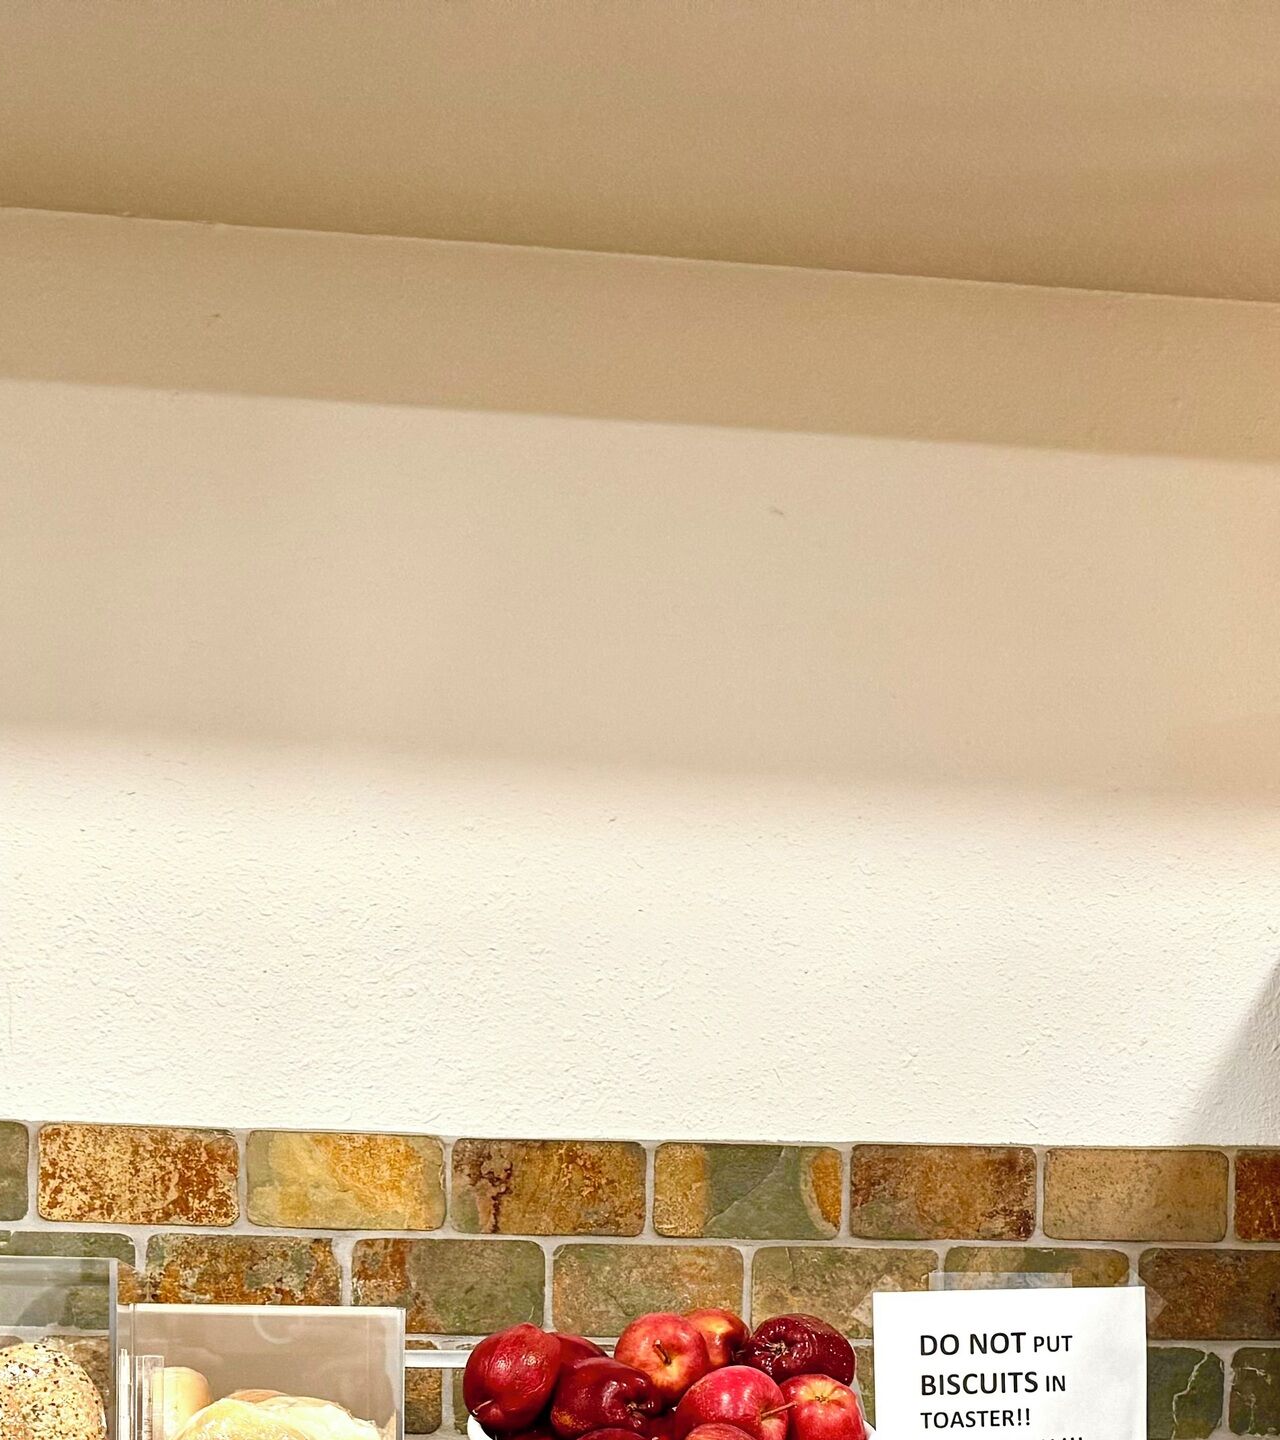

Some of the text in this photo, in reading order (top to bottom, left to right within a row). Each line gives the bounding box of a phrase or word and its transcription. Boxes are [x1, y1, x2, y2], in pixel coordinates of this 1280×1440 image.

[920, 1331, 1074, 1356] DO NOT PUT
[921, 1371, 1066, 1396] BISCUITS IN
[920, 1407, 1031, 1430] TOASTER!!
